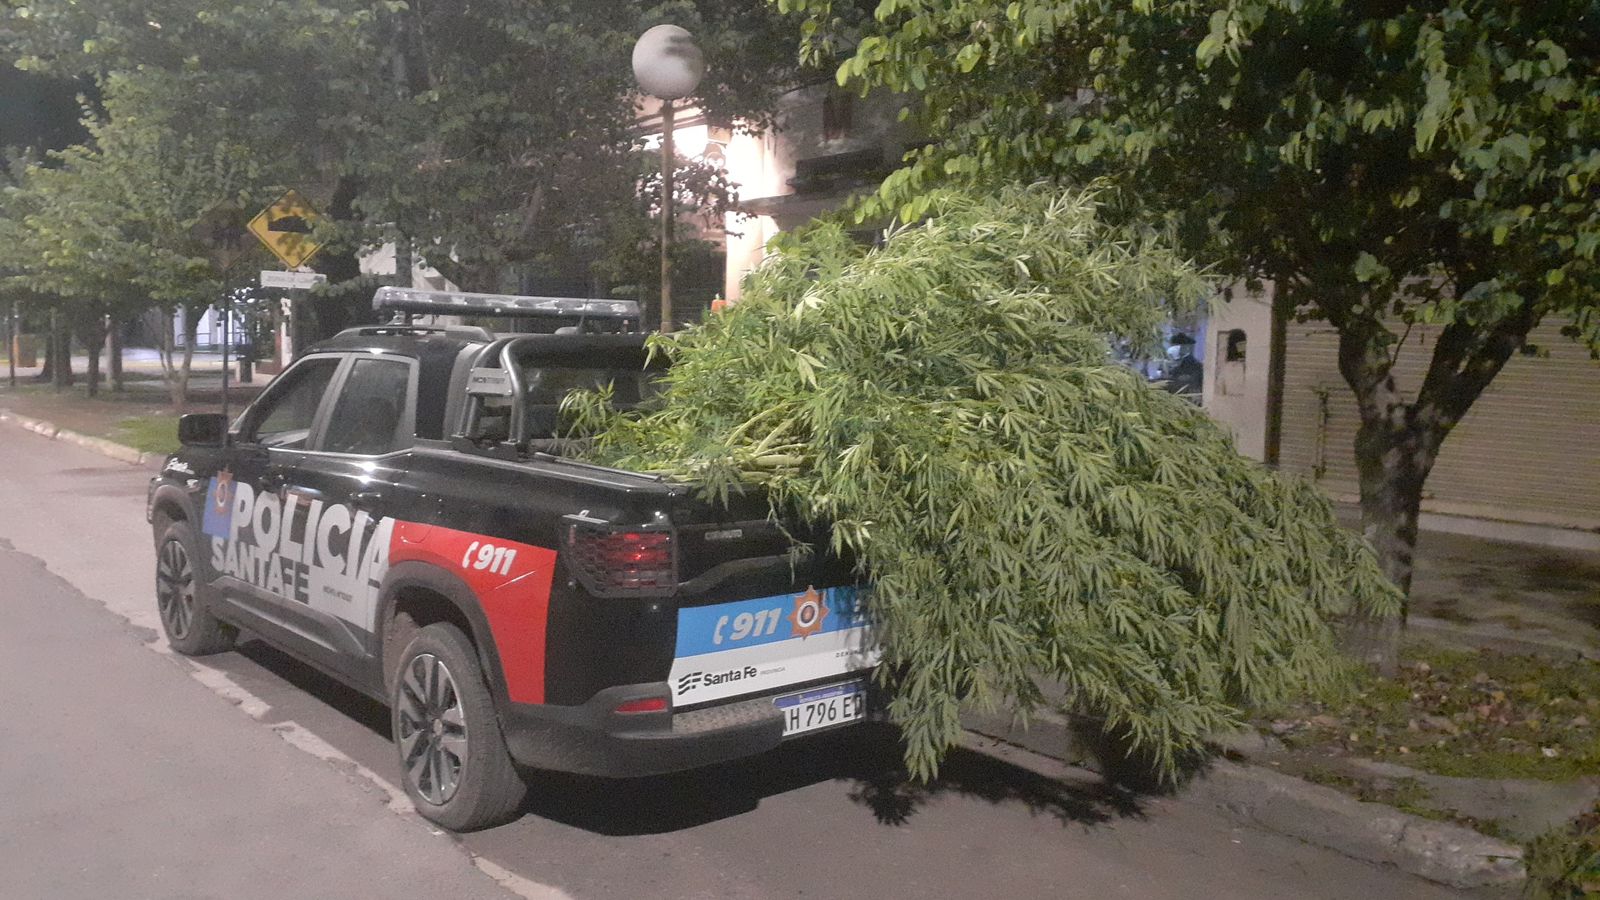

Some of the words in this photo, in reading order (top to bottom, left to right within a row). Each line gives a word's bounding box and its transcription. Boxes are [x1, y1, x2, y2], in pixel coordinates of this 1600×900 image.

[229, 481, 396, 582] POLICIA
[473, 543, 518, 576] 911
[729, 607, 782, 641] 911
[703, 670, 741, 687] Santa
[743, 665, 757, 679] Fe
[783, 707, 800, 732] H
[806, 699, 837, 728] 796
